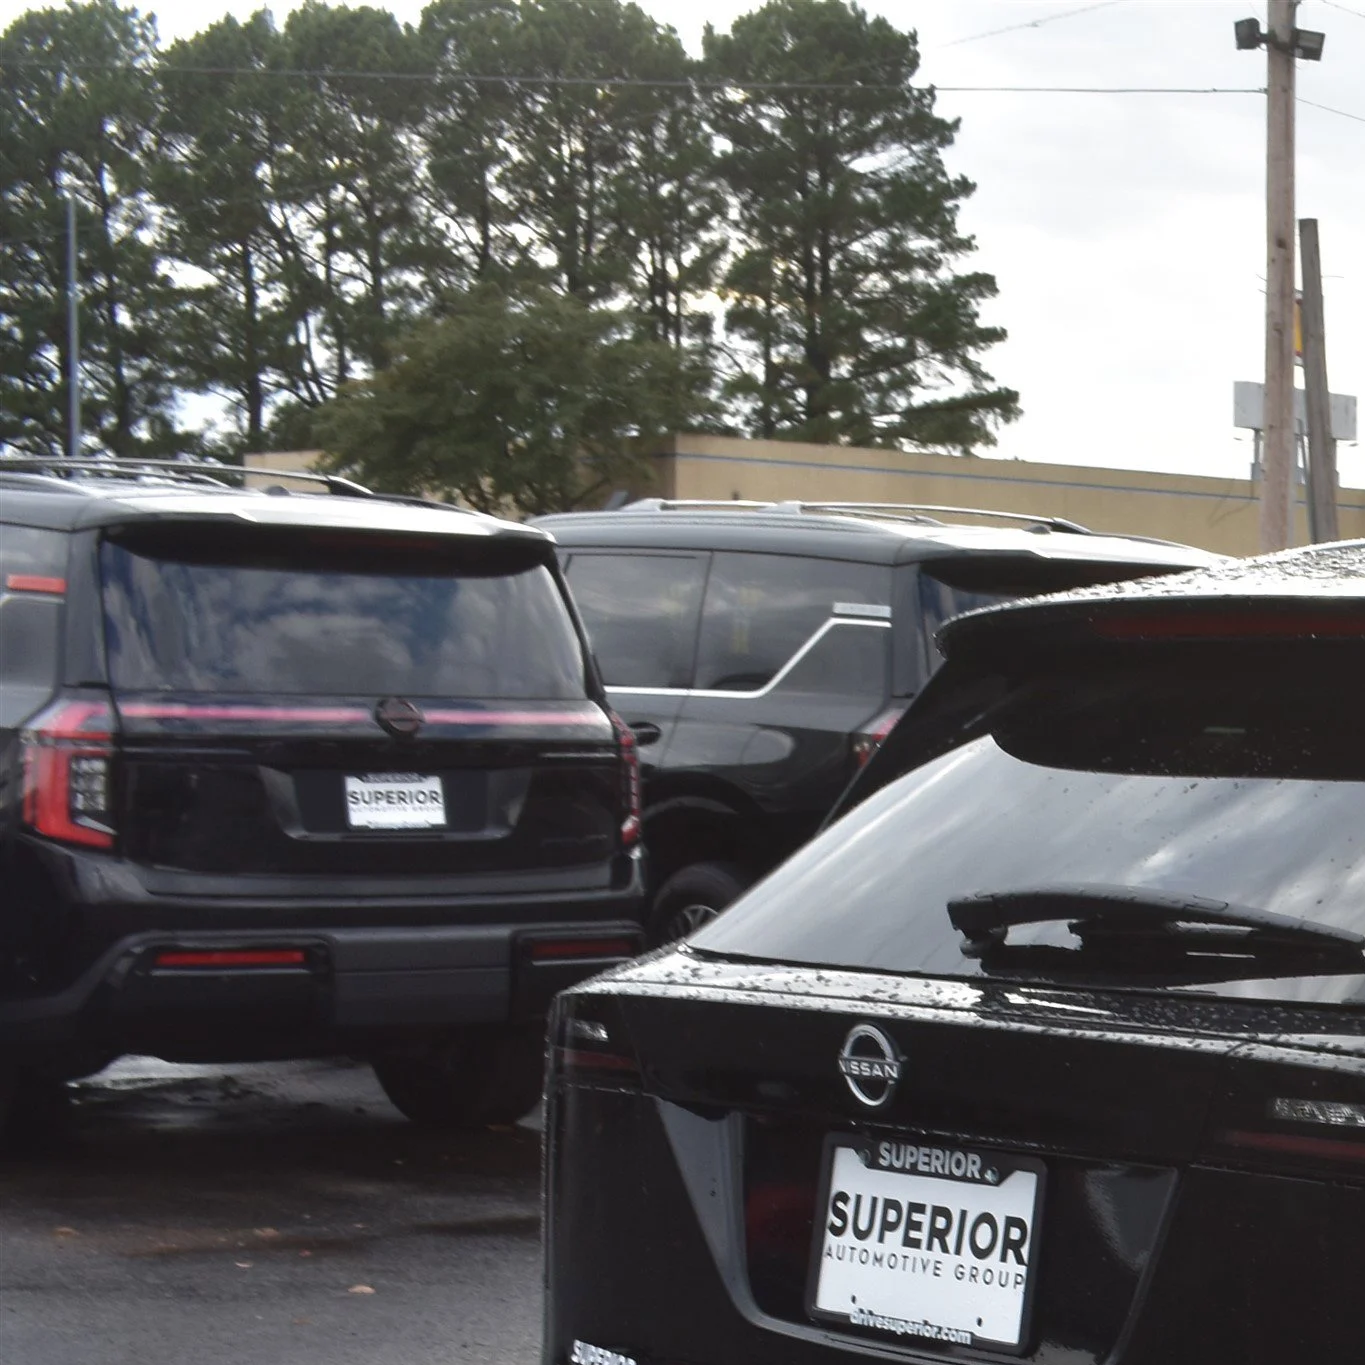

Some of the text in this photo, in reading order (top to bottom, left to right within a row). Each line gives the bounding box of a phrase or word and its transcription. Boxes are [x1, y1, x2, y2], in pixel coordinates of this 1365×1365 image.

[348, 790, 443, 805] SUPERIOR
[838, 1059, 899, 1079] NISSAN
[878, 1141, 982, 1180] SUPERIOR
[828, 1190, 1028, 1267] SUPERIOR
[824, 1243, 1026, 1291] AUTOMOTIVE GROUP
[850, 1308, 972, 1345] drivesuperior.com
